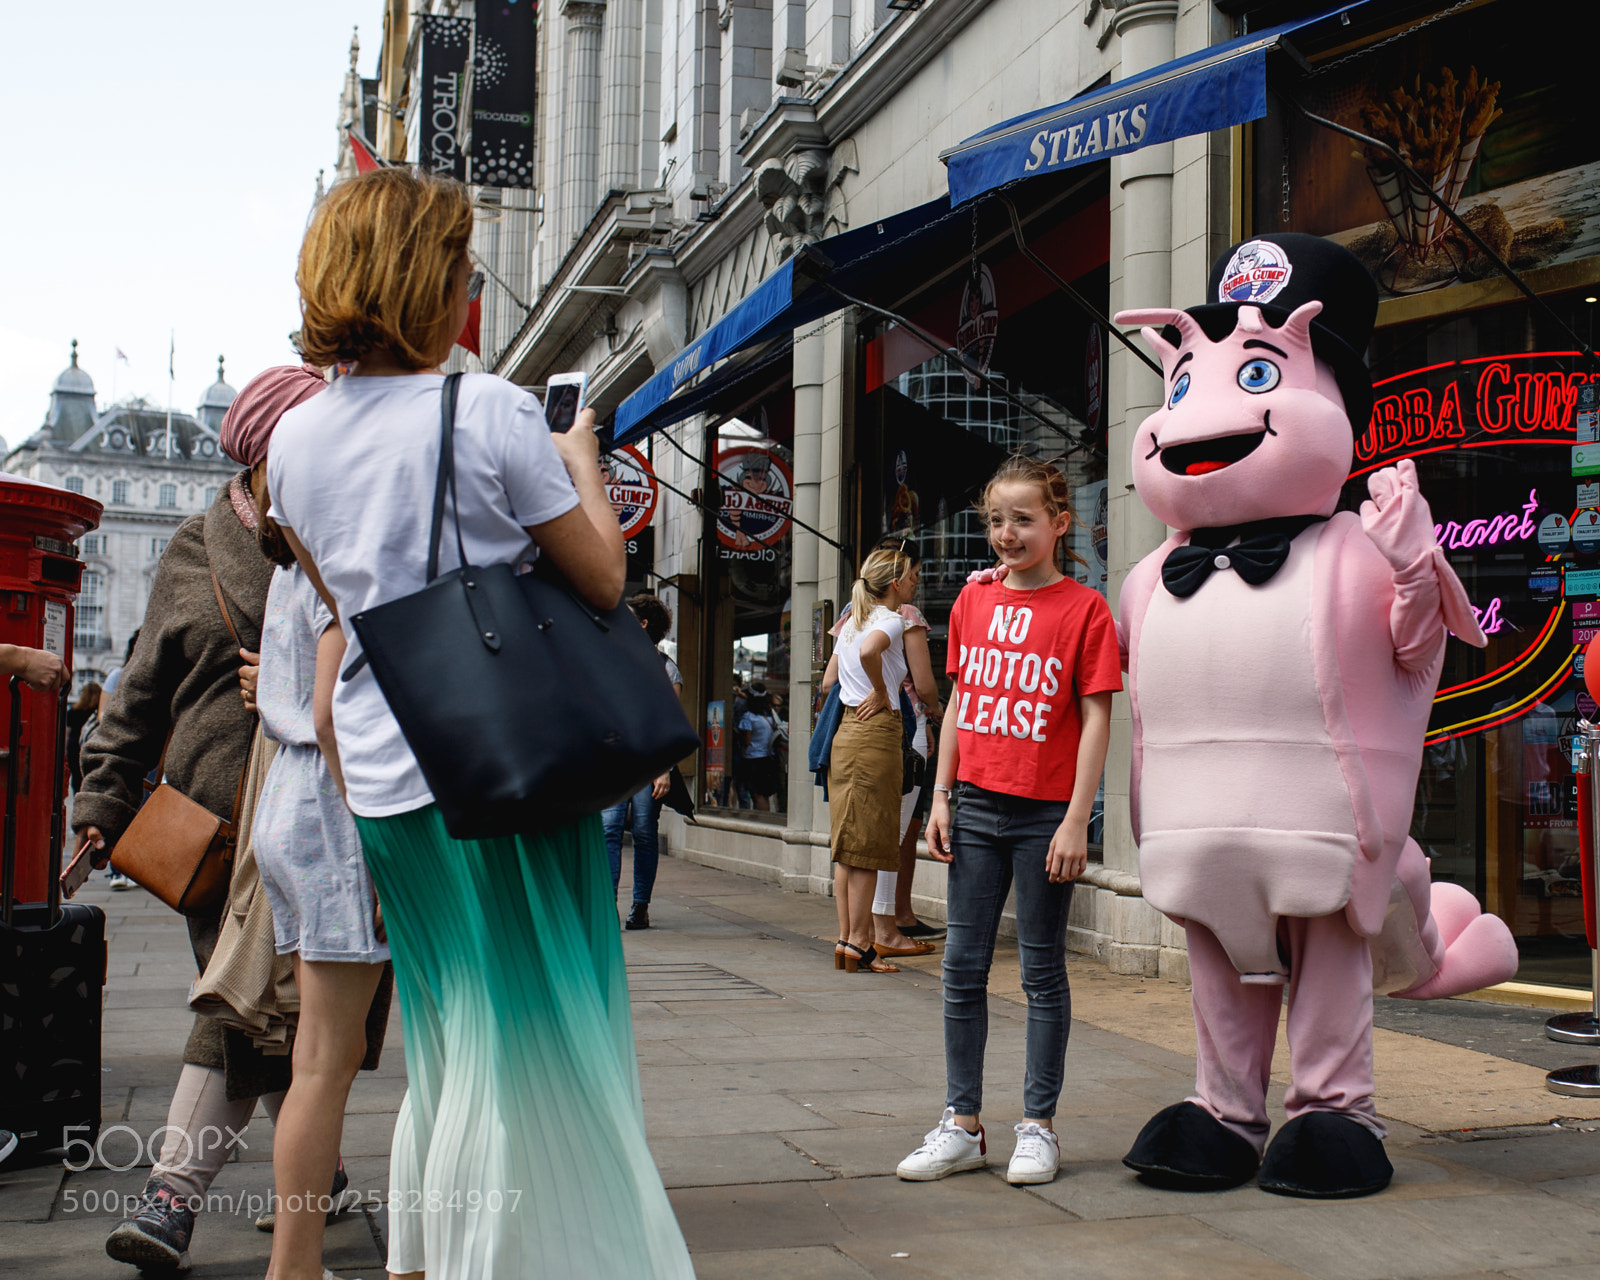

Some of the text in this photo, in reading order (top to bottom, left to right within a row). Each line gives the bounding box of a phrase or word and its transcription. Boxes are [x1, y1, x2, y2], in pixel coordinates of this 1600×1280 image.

[474, 111, 530, 124] TROCADERO
[1024, 103, 1147, 171] STEAKS
[1252, 269, 1285, 280] GUMP
[1477, 362, 1600, 433] GUM
[610, 486, 651, 505] GUMP
[622, 505, 637, 513] CO
[988, 605, 1033, 645] NO
[957, 691, 1052, 742] LEASE
